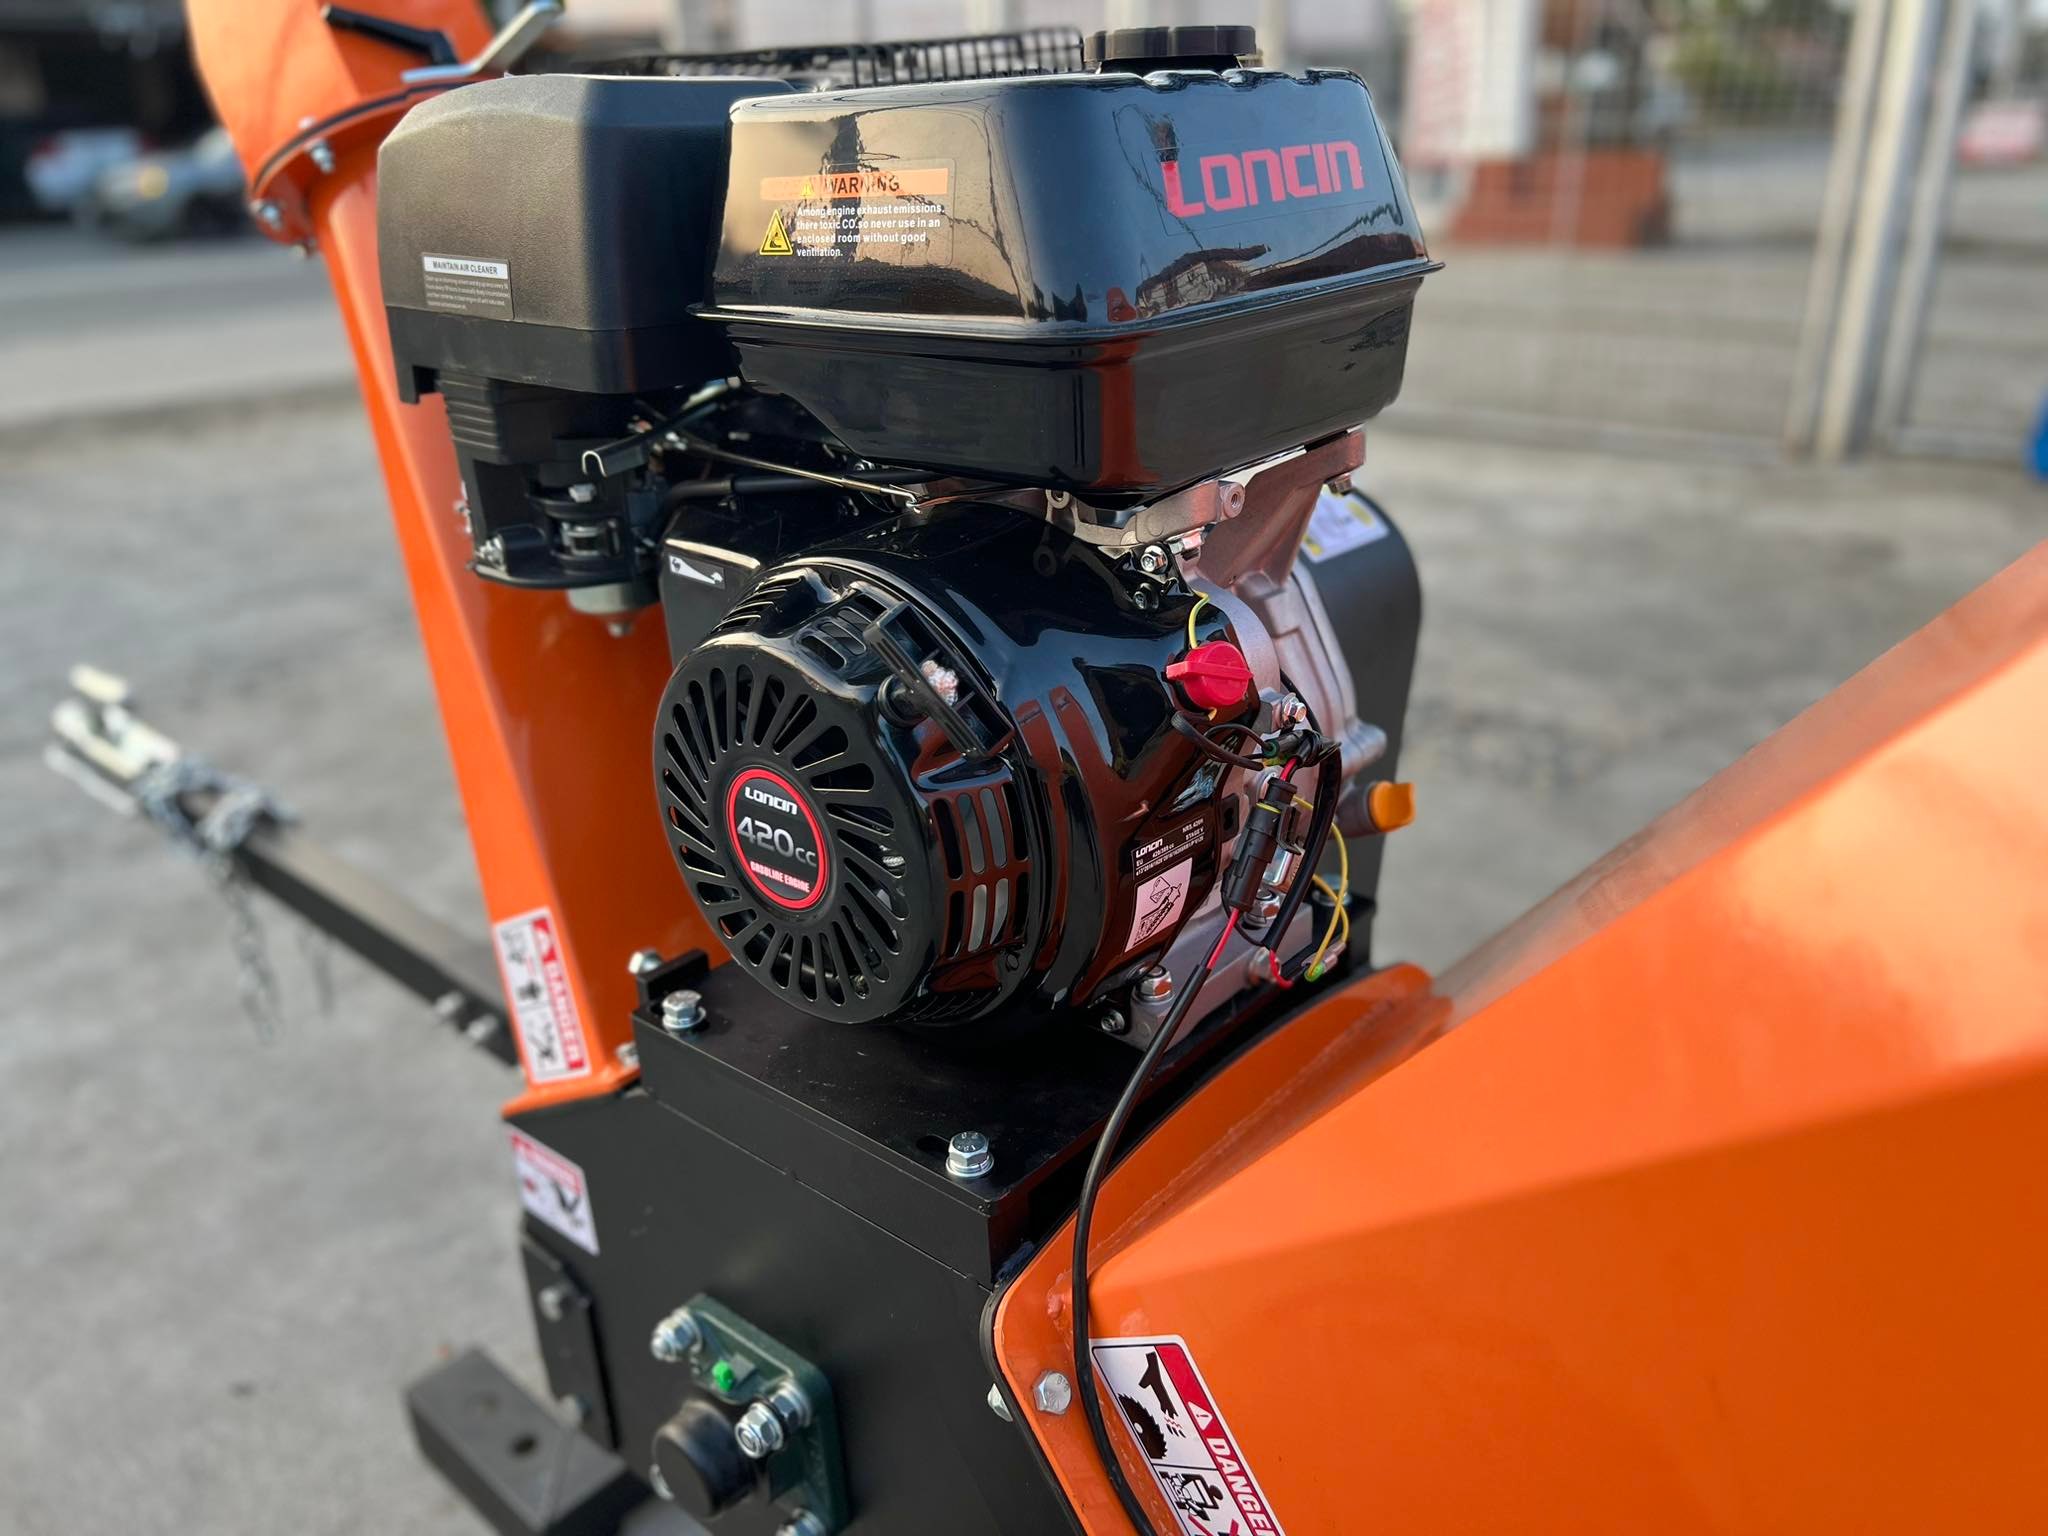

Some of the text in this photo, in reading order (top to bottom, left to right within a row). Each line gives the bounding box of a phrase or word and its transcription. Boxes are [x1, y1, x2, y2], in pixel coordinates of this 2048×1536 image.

[827, 205, 855, 217] engine
[856, 204, 892, 216] exhaust
[796, 221, 818, 229] there
[820, 219, 840, 229] toxic
[870, 220, 897, 229] never
[899, 219, 915, 228] use
[917, 217, 926, 228] in
[928, 219, 940, 228] an
[797, 231, 926, 244] enclosed room without good
[432, 260, 498, 275] MAINTAIN AIR CLEANER
[750, 860, 811, 893] GASOLINE ENGINE
